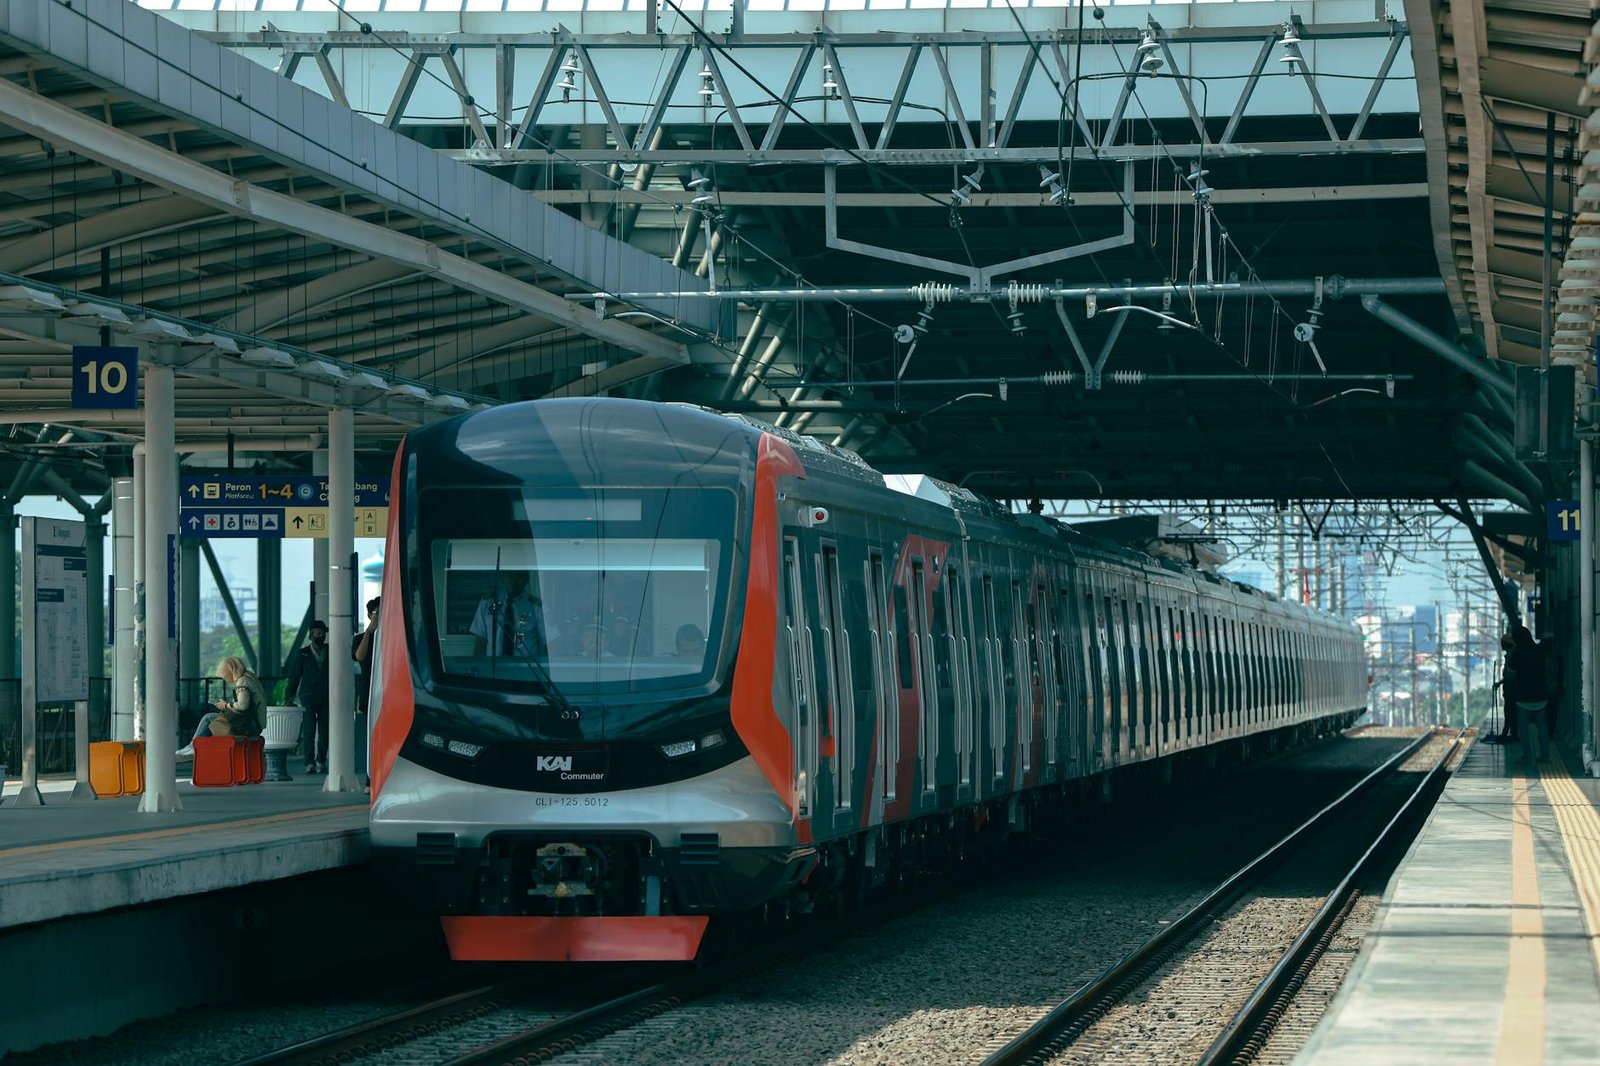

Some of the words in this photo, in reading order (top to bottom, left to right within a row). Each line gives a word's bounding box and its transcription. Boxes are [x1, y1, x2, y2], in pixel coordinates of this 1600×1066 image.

[81, 361, 127, 394] 10
[225, 482, 251, 491] Peron
[1557, 509, 1580, 531] 11
[537, 756, 572, 771] KAI
[560, 772, 604, 780] Commuter
